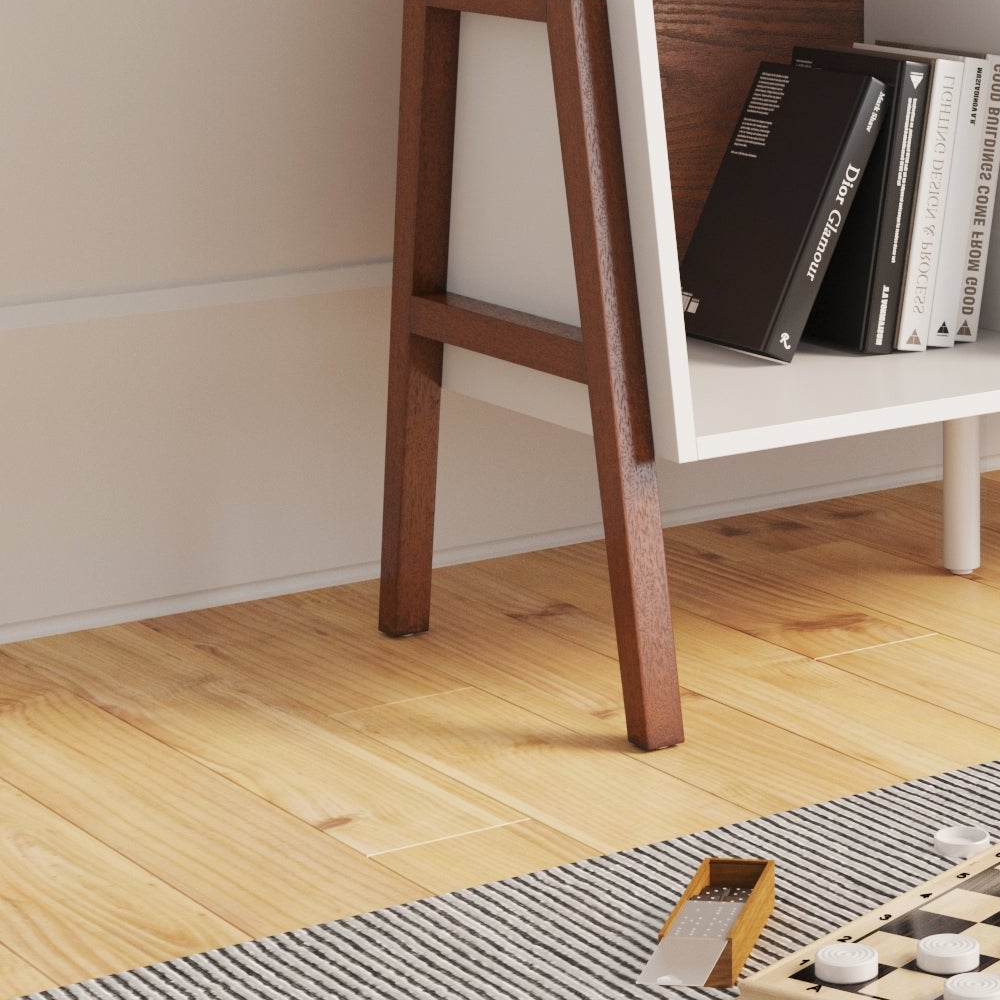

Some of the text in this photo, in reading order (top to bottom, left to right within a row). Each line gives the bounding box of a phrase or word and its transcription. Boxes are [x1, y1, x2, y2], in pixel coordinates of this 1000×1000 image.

[865, 91, 886, 133] Mark Shaw
[806, 163, 861, 282] Dior Glamour
[879, 913, 892, 921] 3
[836, 935, 853, 943] 2
[805, 984, 822, 993] A
